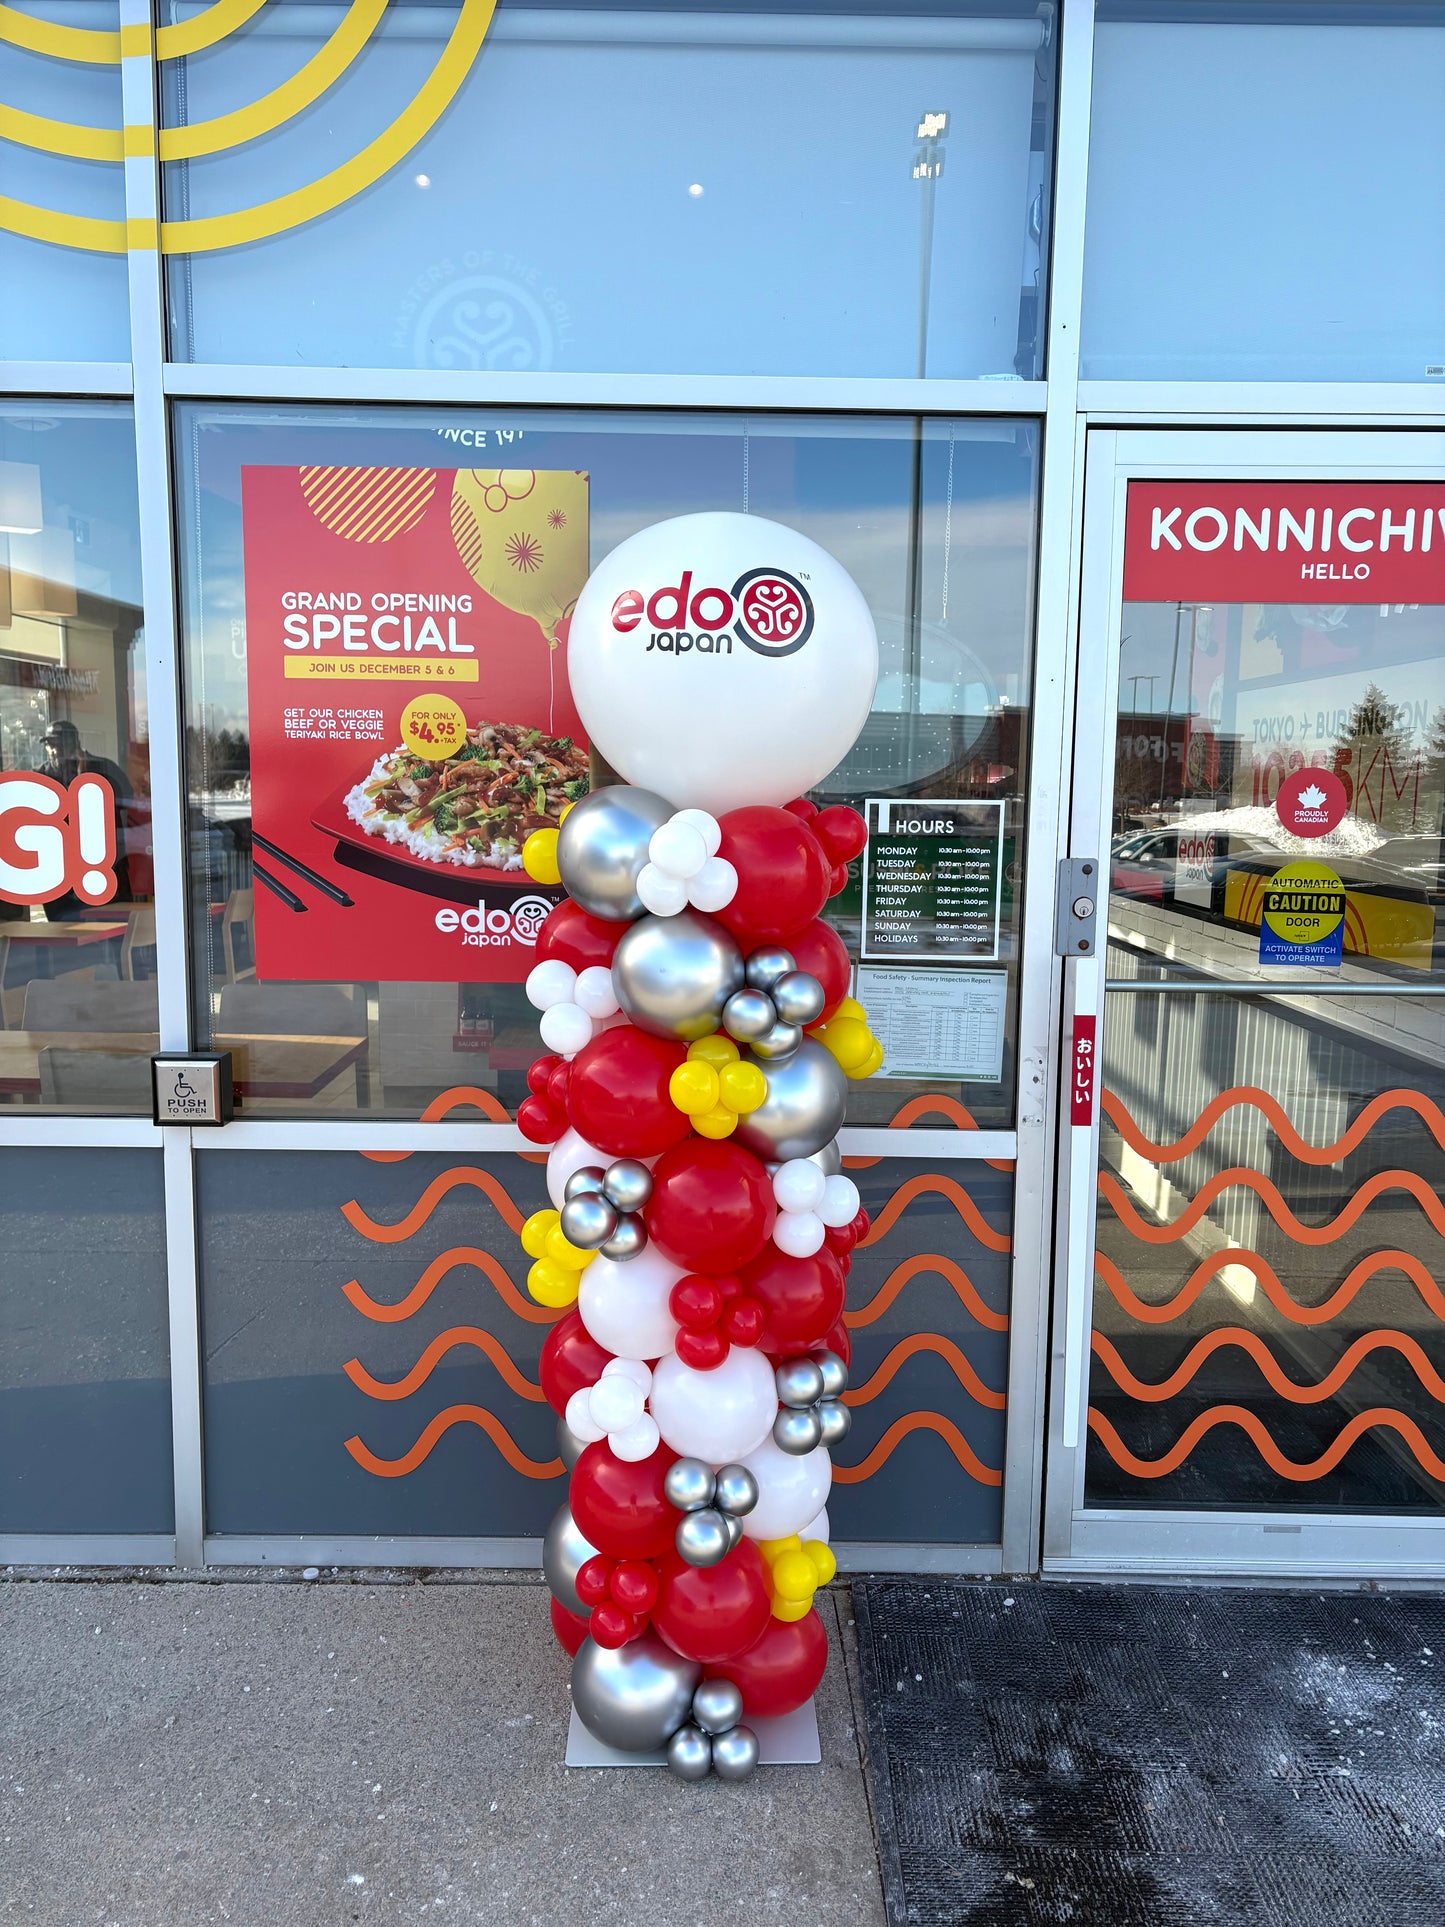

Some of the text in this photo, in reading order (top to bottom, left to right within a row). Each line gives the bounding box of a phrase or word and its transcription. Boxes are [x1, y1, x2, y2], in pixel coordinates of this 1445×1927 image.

[462, 249, 497, 269] OF
[1150, 507, 1445, 553] KONNICHI
[1301, 563, 1370, 580] HELLO
[281, 591, 473, 613] GRAND OPENING
[611, 571, 734, 633] edo
[283, 613, 475, 653] SPECIAL
[645, 631, 733, 656] japan
[309, 663, 455, 675] JOIN US DECEMBER 5 & 6
[284, 708, 383, 719] GET OUR CHICKEN
[411, 712, 457, 720] FOR ONLY
[284, 719, 384, 730] BEEF OR VEGGIE
[1253, 714, 1295, 744] TOKYO
[284, 729, 384, 740] TERIYAKI RICE BOWL
[896, 820, 954, 834] HOURS
[877, 847, 918, 855] MONDAY
[1178, 833, 1205, 866] edo
[877, 860, 916, 868] TUESDAY
[876, 872, 932, 880] WEDNESDAY
[876, 885, 922, 893] THURSDAY
[1271, 878, 1339, 890] AUTOMATIC
[875, 897, 907, 905] FRIDAY
[1268, 894, 1341, 912] CAUTION
[435, 899, 511, 933] edo
[875, 910, 921, 918] SATURDAY
[874, 922, 911, 930] SUNDAY
[1285, 917, 1320, 928] DOOR
[462, 932, 511, 947] japan
[874, 934, 918, 943] HOLIDAYS
[1265, 945, 1336, 954] ACTIVATE SWITCH
[1275, 954, 1325, 963] TO OPERATE
[889, 974, 907, 982] Safety
[911, 975, 939, 983] Summary
[940, 976, 970, 984] Inspection
[971, 977, 991, 985] Report
[1075, 1038, 1092, 1104] おいしい
[168, 1099, 206, 1107] PUSH
